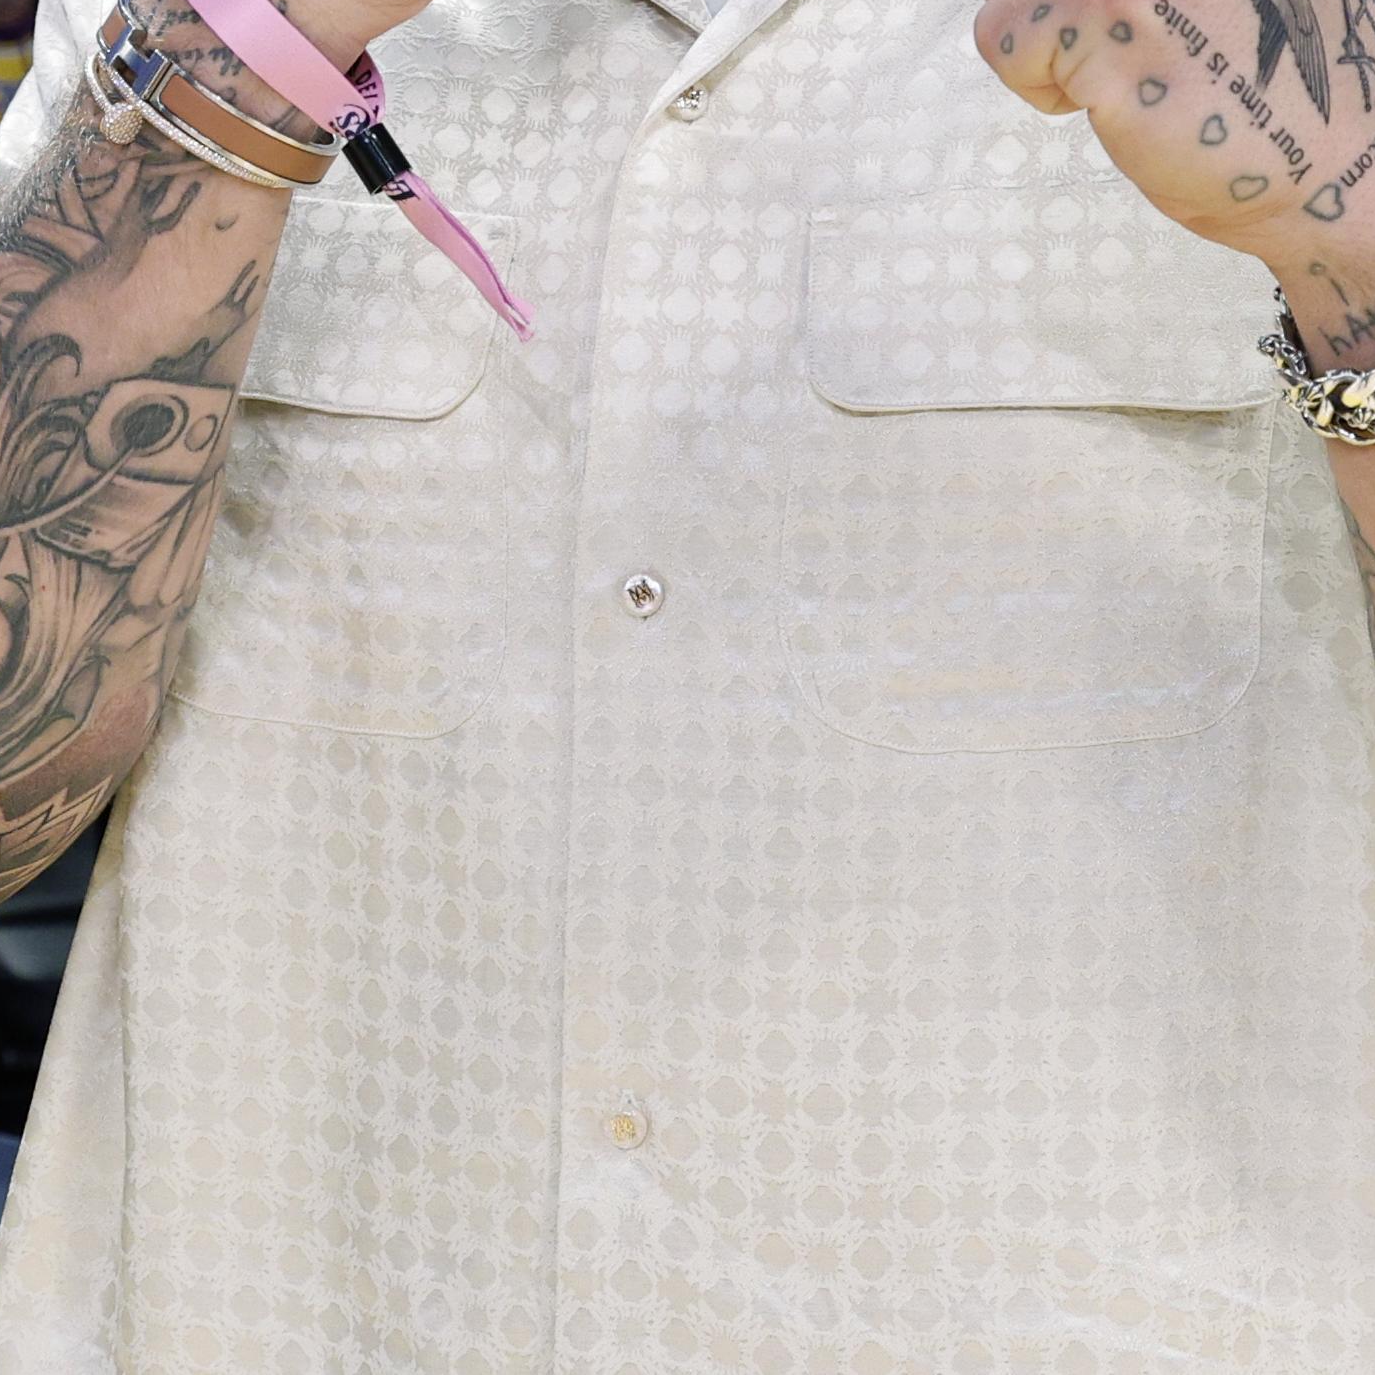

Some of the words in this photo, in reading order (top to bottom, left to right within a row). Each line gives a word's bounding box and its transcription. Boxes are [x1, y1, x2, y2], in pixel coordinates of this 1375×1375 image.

[1206, 51, 1230, 85] is
[1229, 74, 1274, 130] time
[1269, 127, 1313, 186] Your
